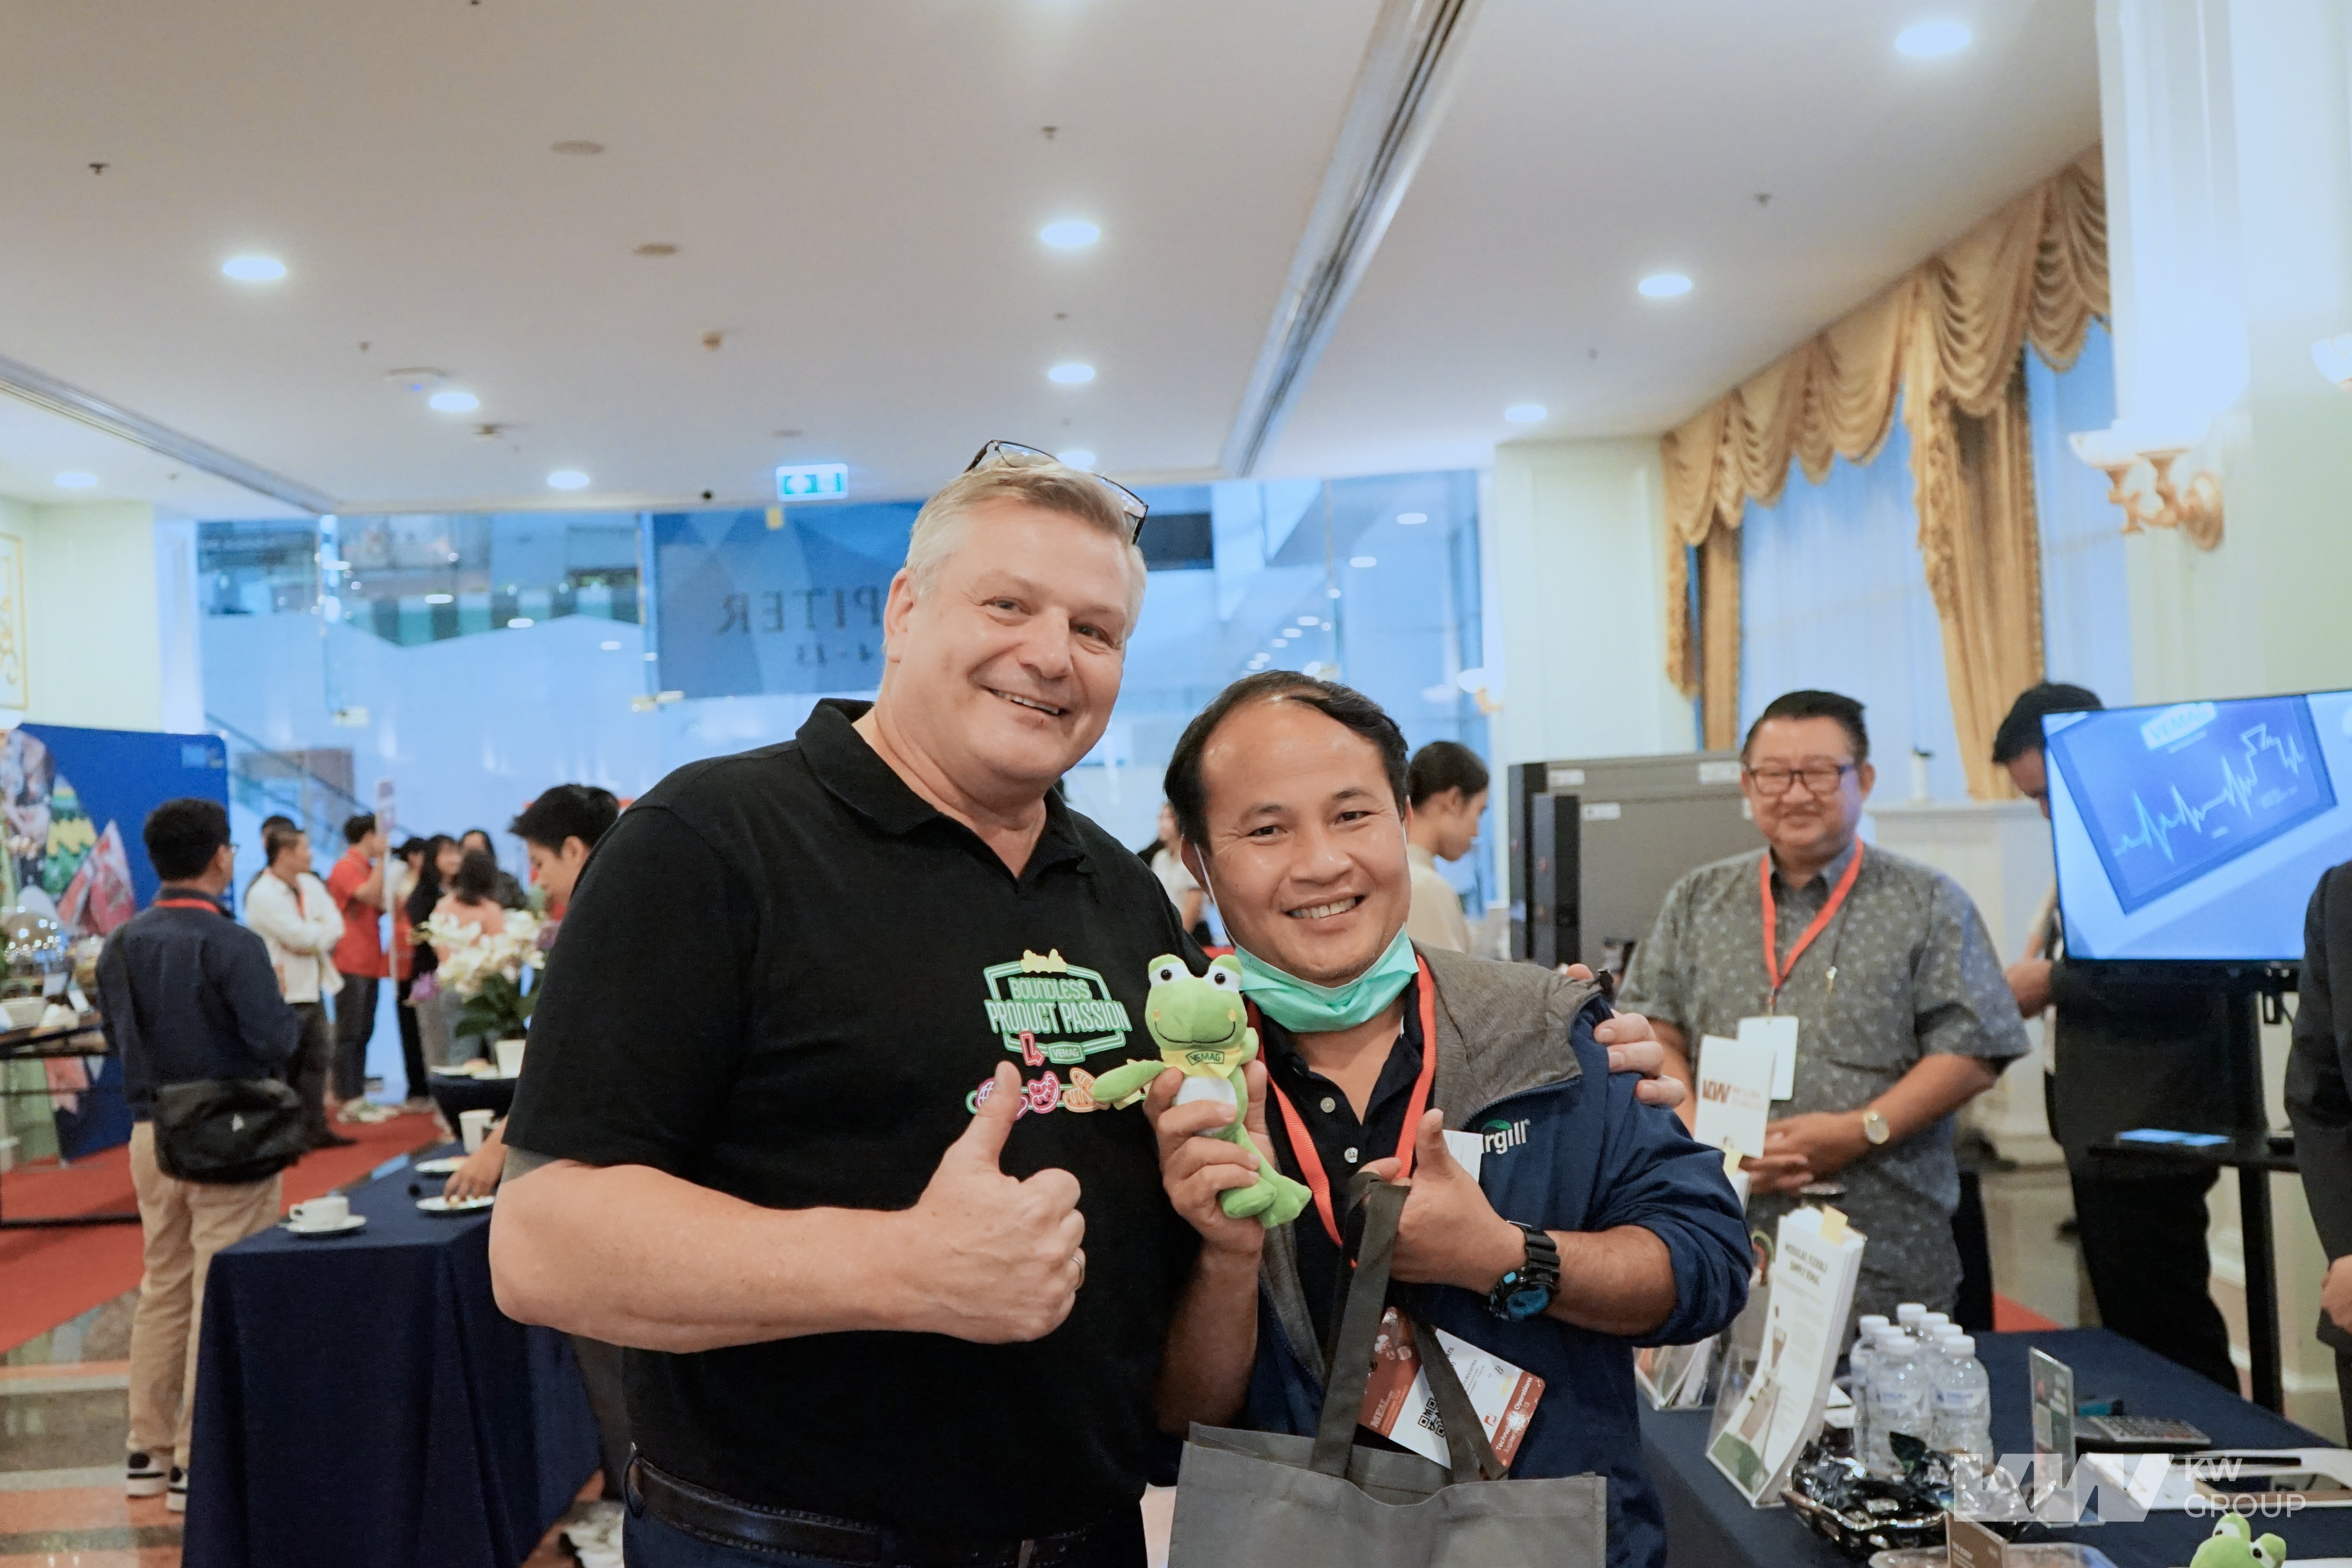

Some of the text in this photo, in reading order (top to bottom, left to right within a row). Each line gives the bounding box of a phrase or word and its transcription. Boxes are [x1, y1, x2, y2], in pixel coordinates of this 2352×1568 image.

[1009, 978, 1091, 1000] BOUNDLESS
[985, 1000, 1132, 1032] PRODUCT PASSION
[1052, 1048, 1079, 1058] VEMAG
[1190, 1052, 1221, 1062] VEMAG
[1482, 1120, 1527, 1154] rgill
[1514, 1377, 1533, 1411] Operations
